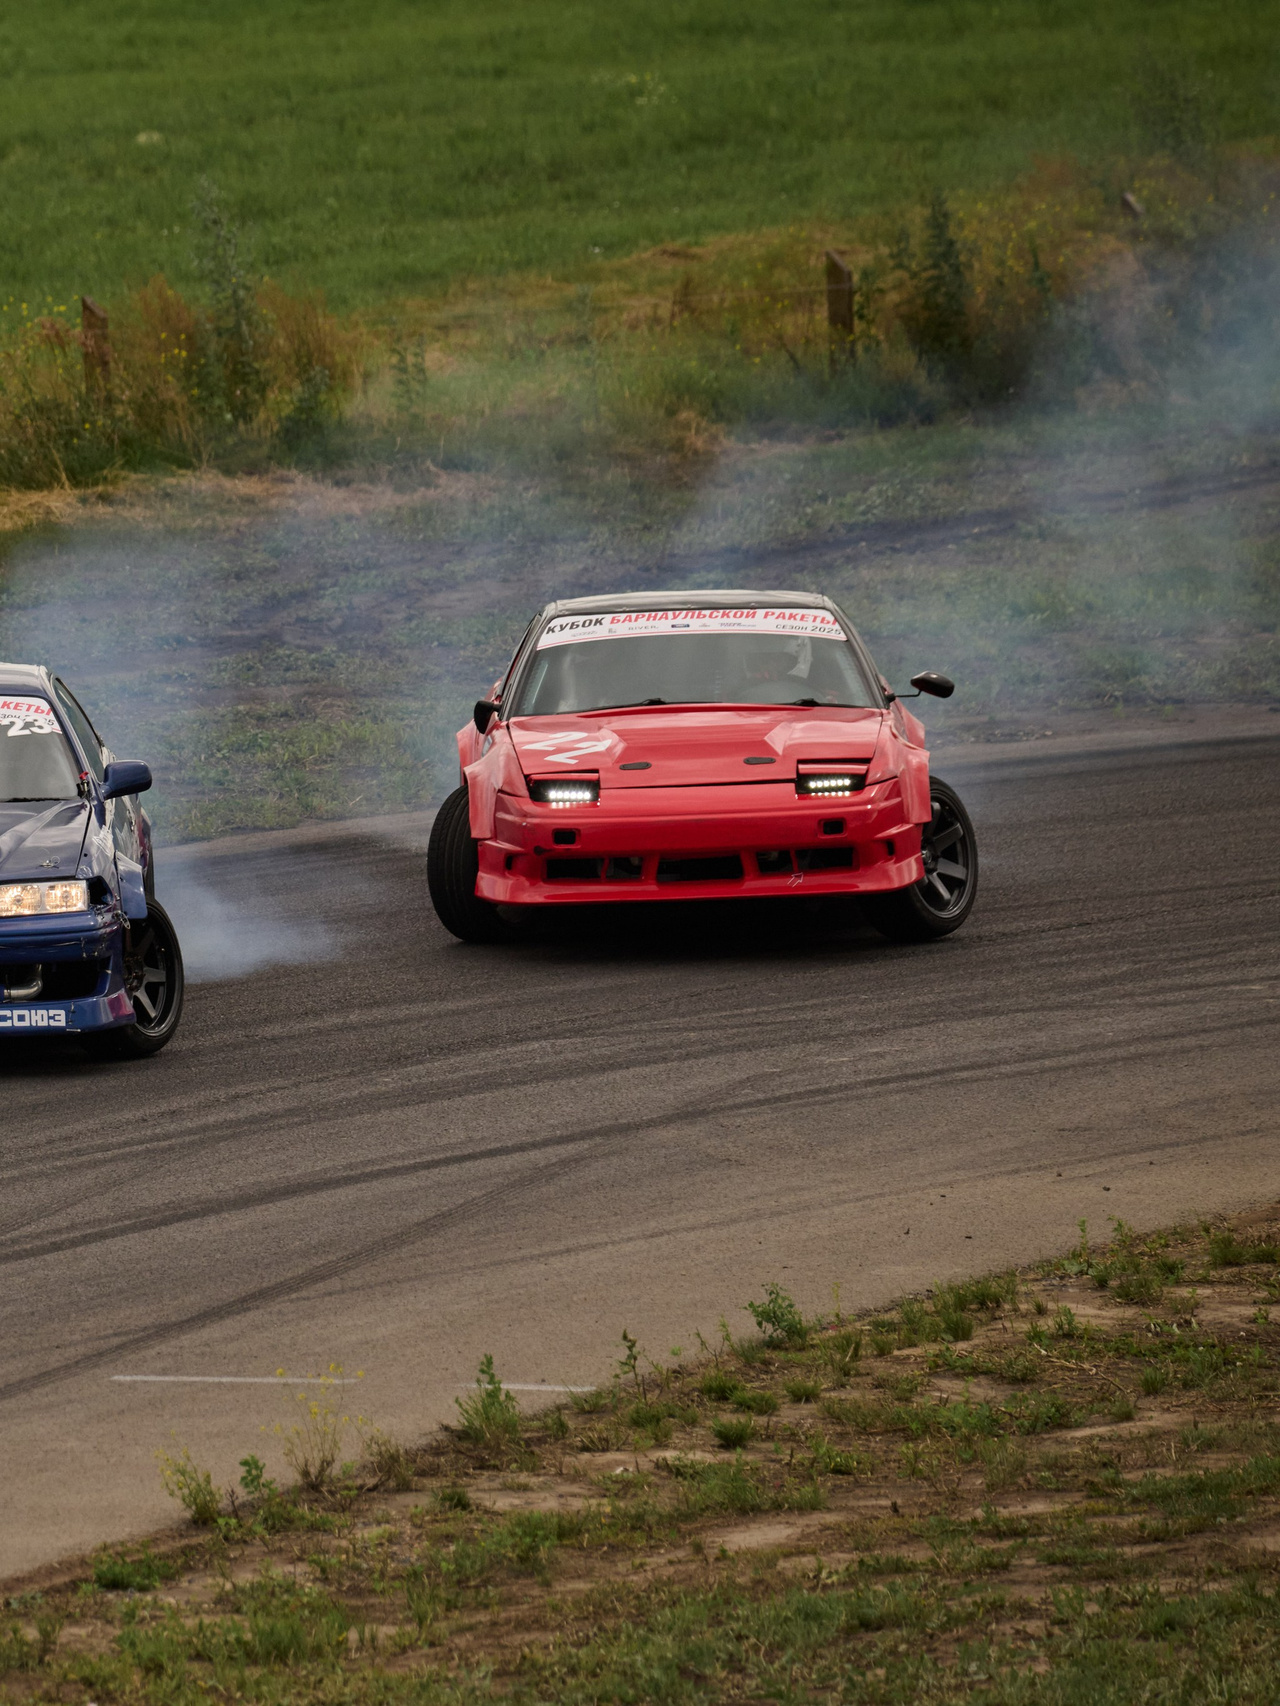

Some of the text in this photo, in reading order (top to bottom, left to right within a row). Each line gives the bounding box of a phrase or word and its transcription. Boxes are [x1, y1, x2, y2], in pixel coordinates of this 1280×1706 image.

[545, 616, 606, 635] КУБОК
[609, 608, 757, 625] БАРНАУЛЬСКОЙ
[763, 610, 838, 626] РАКЕТЫ
[775, 623, 842, 635] СЕЗОН 2025
[0, 716, 53, 737] 23
[521, 731, 613, 765] 22
